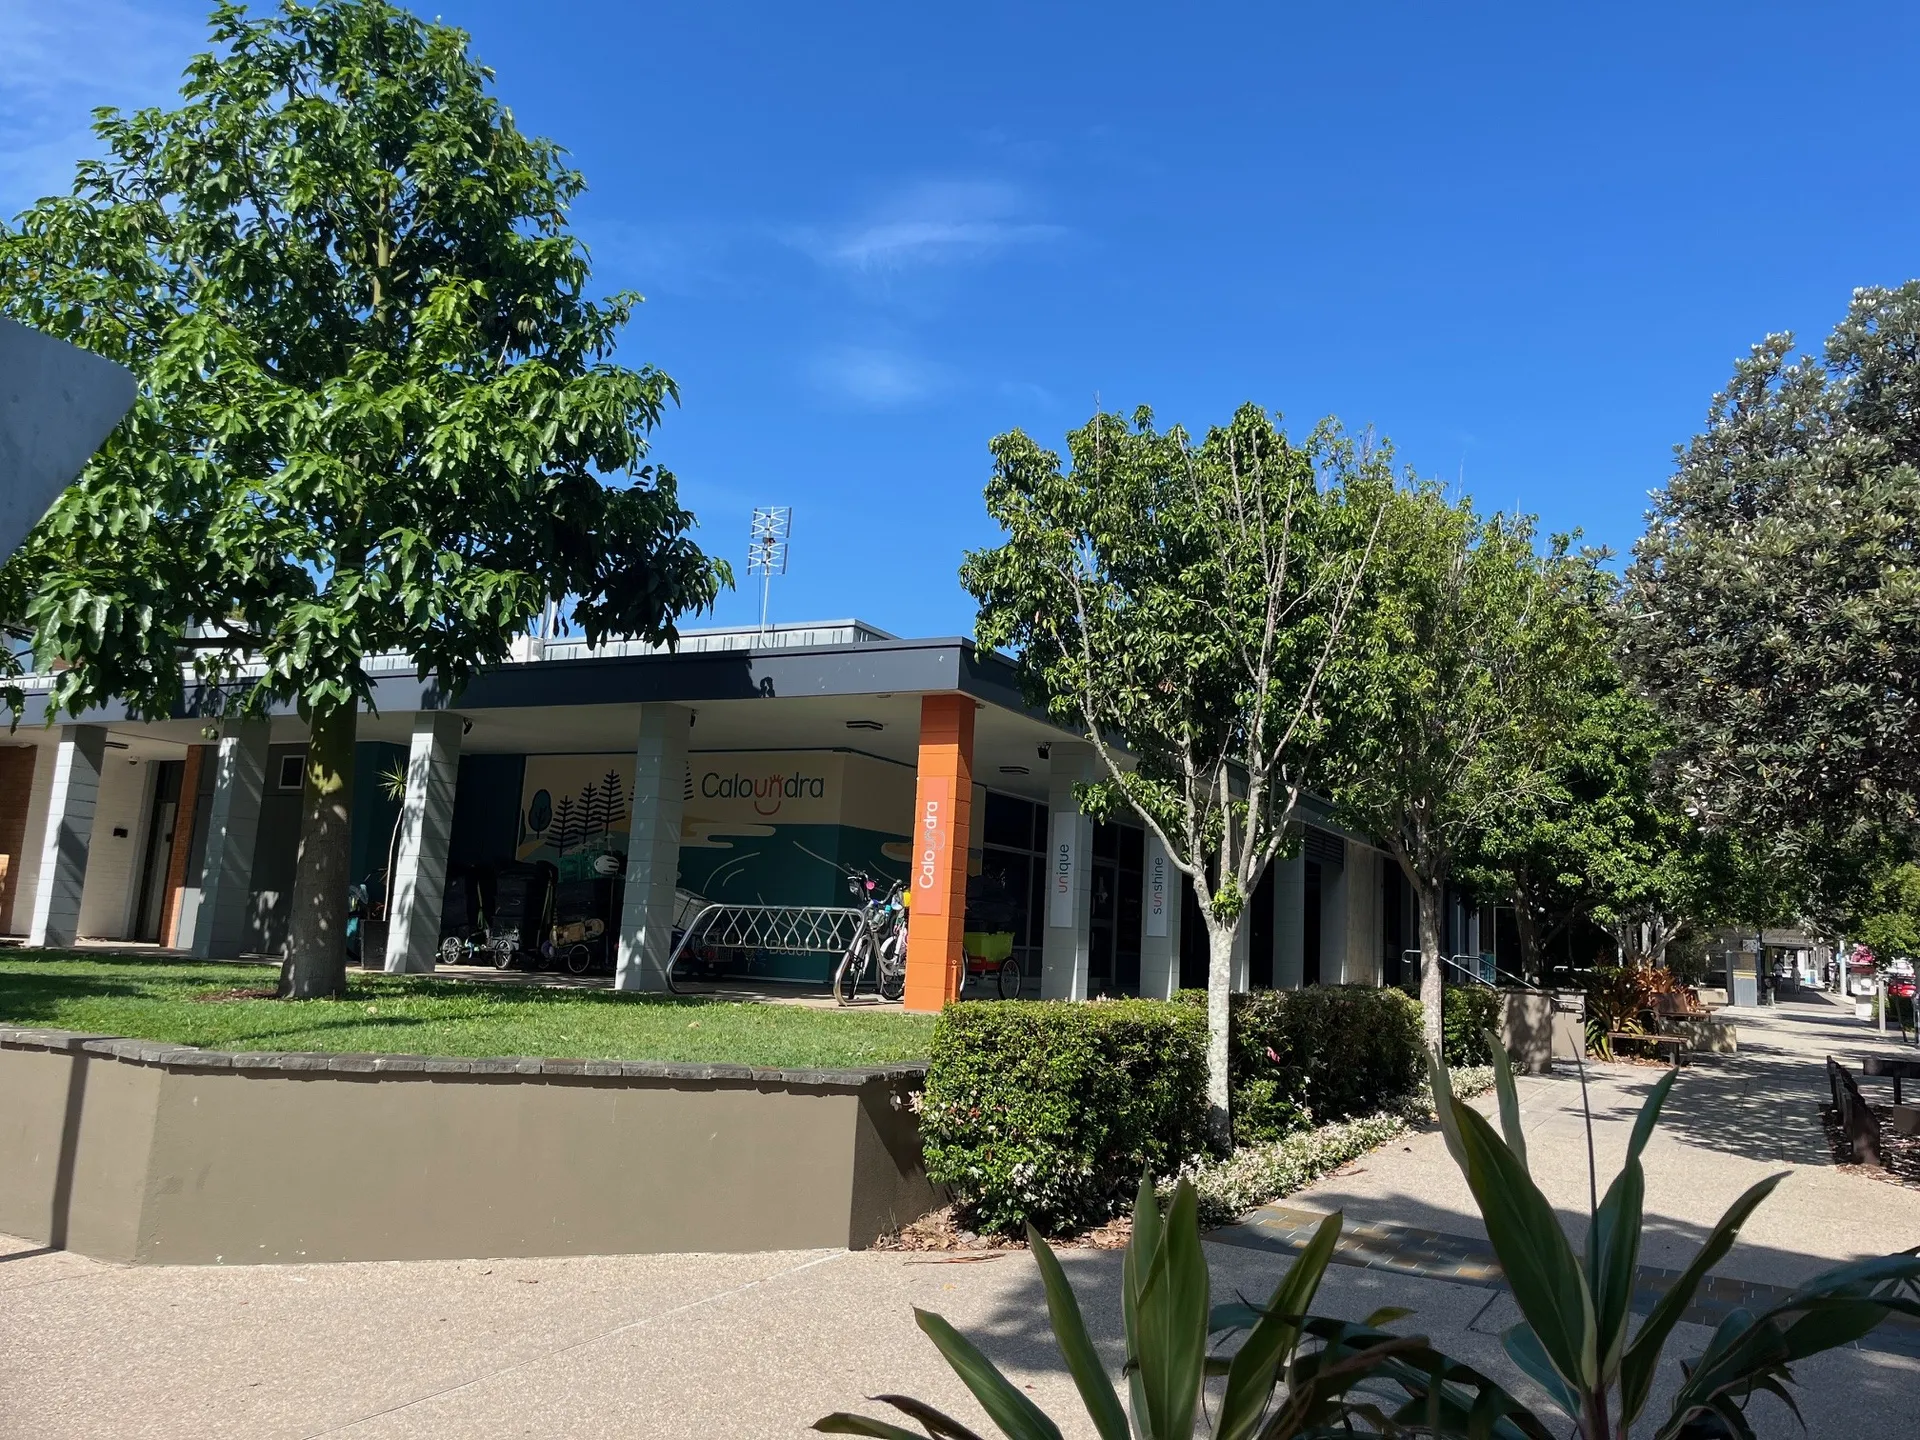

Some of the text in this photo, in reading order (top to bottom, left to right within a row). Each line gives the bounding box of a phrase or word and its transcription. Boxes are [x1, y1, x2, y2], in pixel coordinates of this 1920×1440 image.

[702, 772, 824, 798] Caloundra
[919, 801, 939, 888] Caloundra
[1056, 844, 1071, 893] unique
[1152, 857, 1163, 915] sunshine
